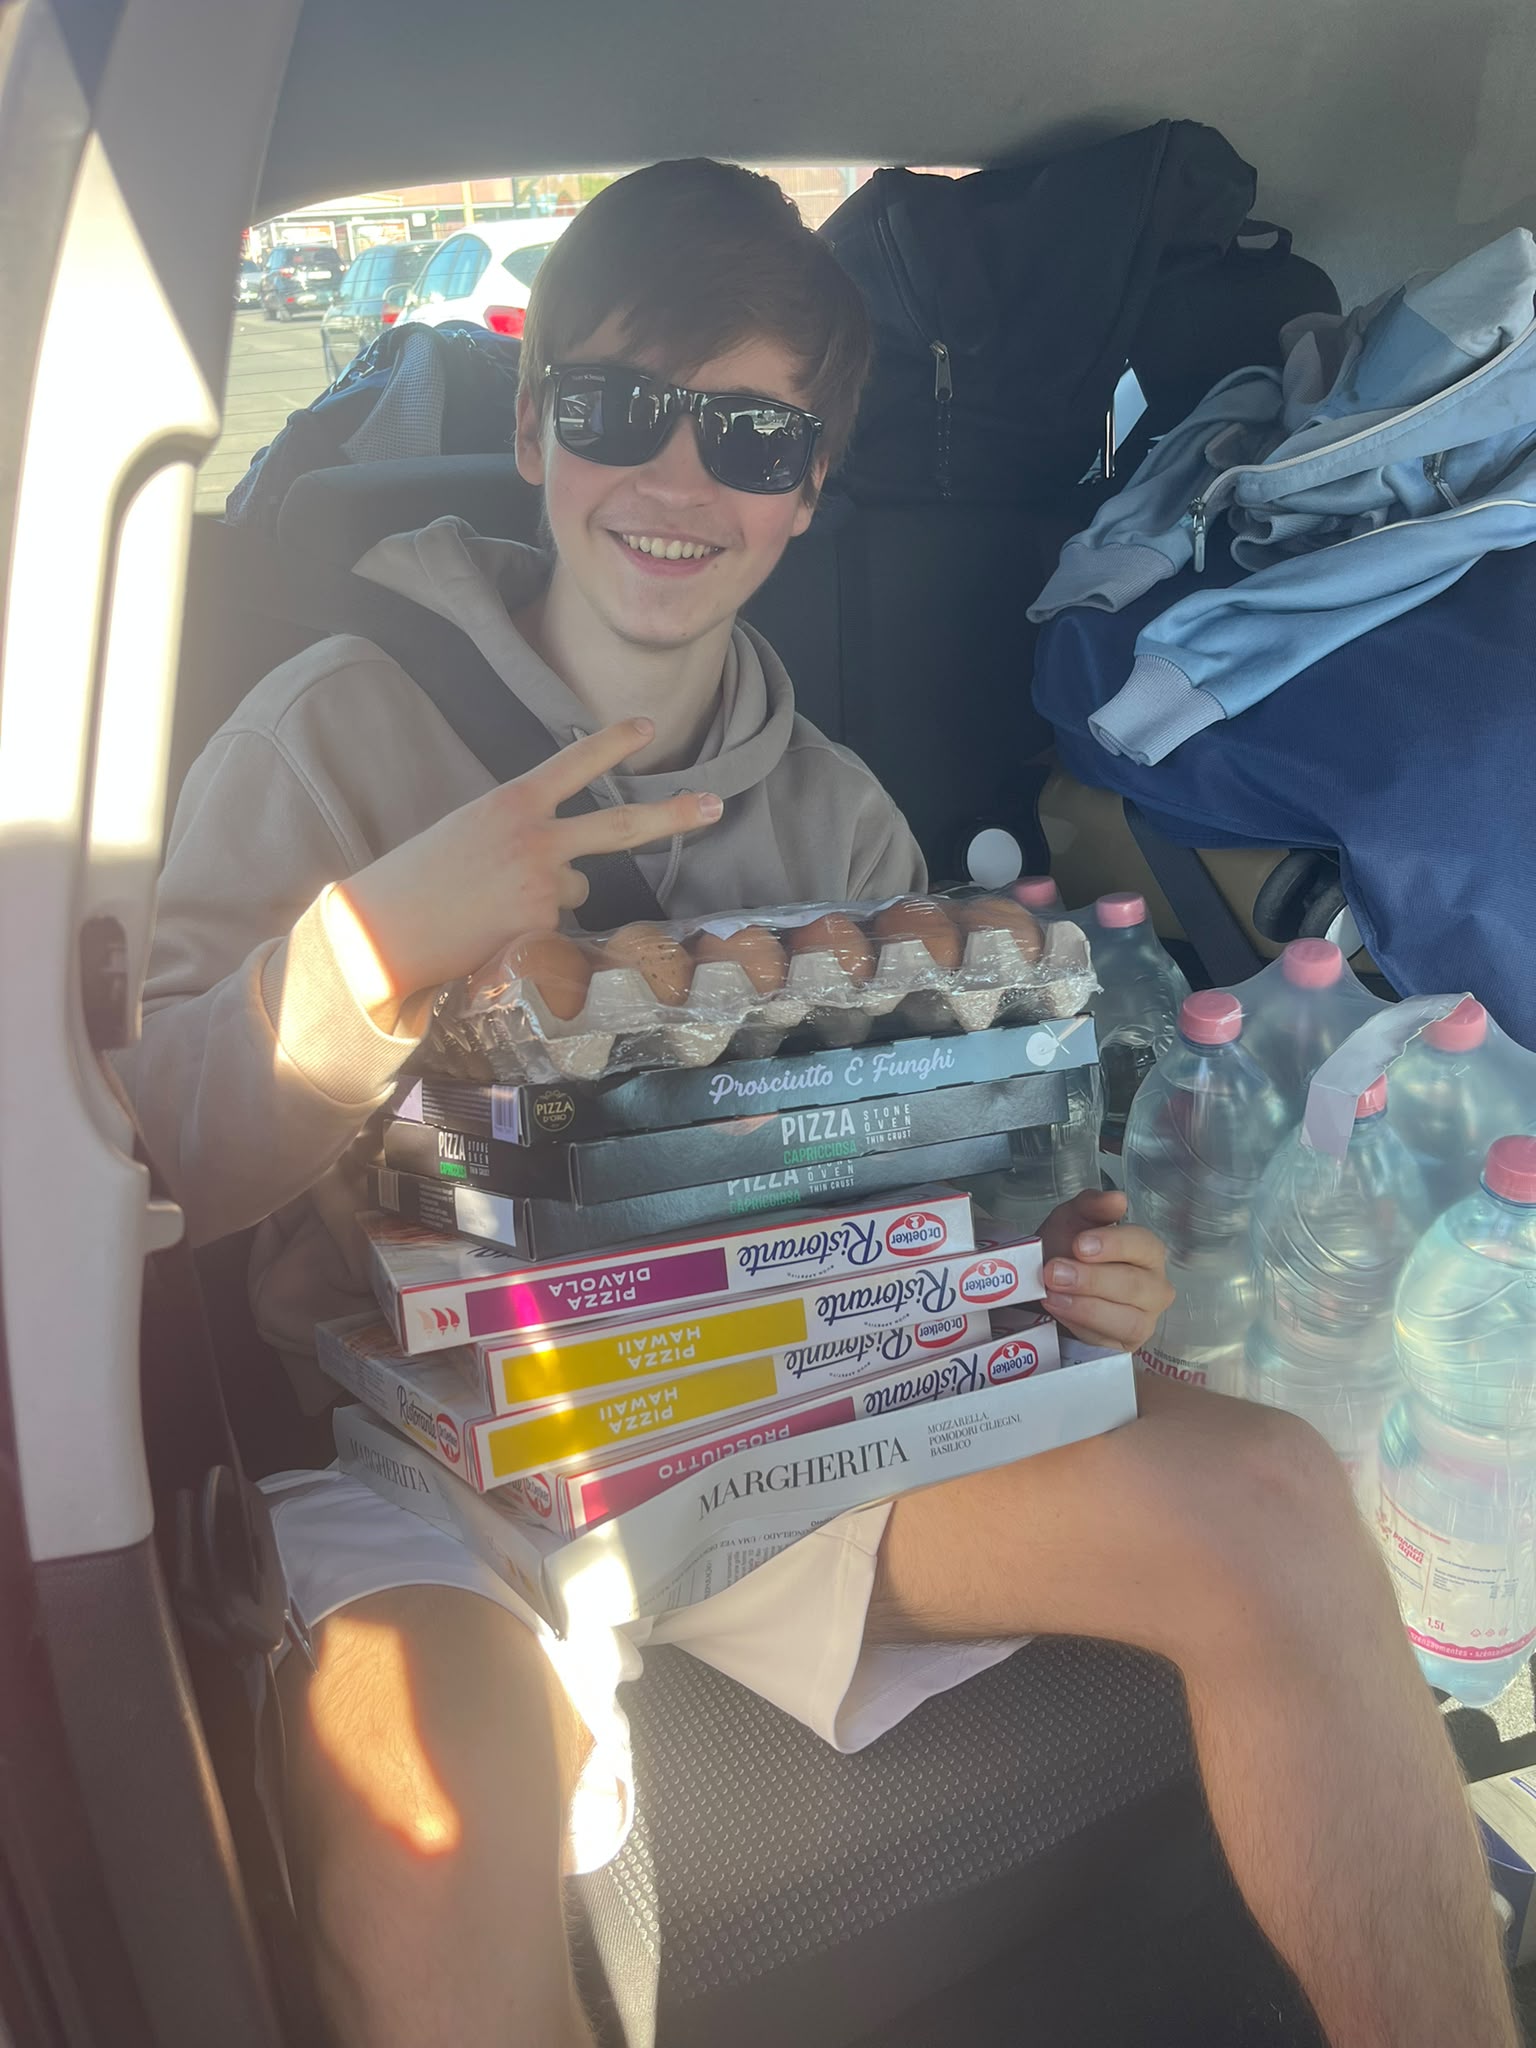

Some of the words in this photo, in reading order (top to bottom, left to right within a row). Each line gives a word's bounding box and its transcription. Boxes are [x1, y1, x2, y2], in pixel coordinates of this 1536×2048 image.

[709, 1063, 833, 1105] Prosciutto
[844, 1056, 864, 1086] E
[872, 1047, 955, 1083] Funghi
[536, 1101, 574, 1116] PIZZA
[863, 1104, 911, 1121] STONE
[864, 1115, 911, 1132] OVEN
[780, 1107, 856, 1146] PIZZA
[865, 1133, 885, 1145] THIN
[887, 1129, 912, 1142] CRUST
[438, 1131, 466, 1161] PIZZA
[783, 1140, 857, 1165] CAPRICCIOSA
[807, 1165, 854, 1182] OVEN
[809, 1182, 828, 1194] THIN
[830, 1179, 855, 1191] CRUST
[736, 1219, 883, 1276] Ristorante
[549, 1267, 651, 1297] DIAVOLA
[815, 1266, 957, 1326] Ristorante
[567, 1286, 636, 1311] PIZZA
[617, 1325, 701, 1355] HAWAII
[784, 1326, 913, 1379] Ristorante
[628, 1344, 696, 1371] PIZZA
[863, 1353, 986, 1416] Ristorante
[600, 1387, 678, 1421] HAWAII
[609, 1405, 673, 1435] PIZZA
[929, 1426, 978, 1446] POMODORI
[930, 1438, 972, 1457] BASILICO
[348, 1437, 431, 1494] MARGHERITA
[658, 1424, 790, 1480] PROSCIUTTO
[699, 1436, 910, 1521] MARGHERITA
[1393, 1531, 1425, 1558] pannon
[1398, 1542, 1424, 1565] aqua
